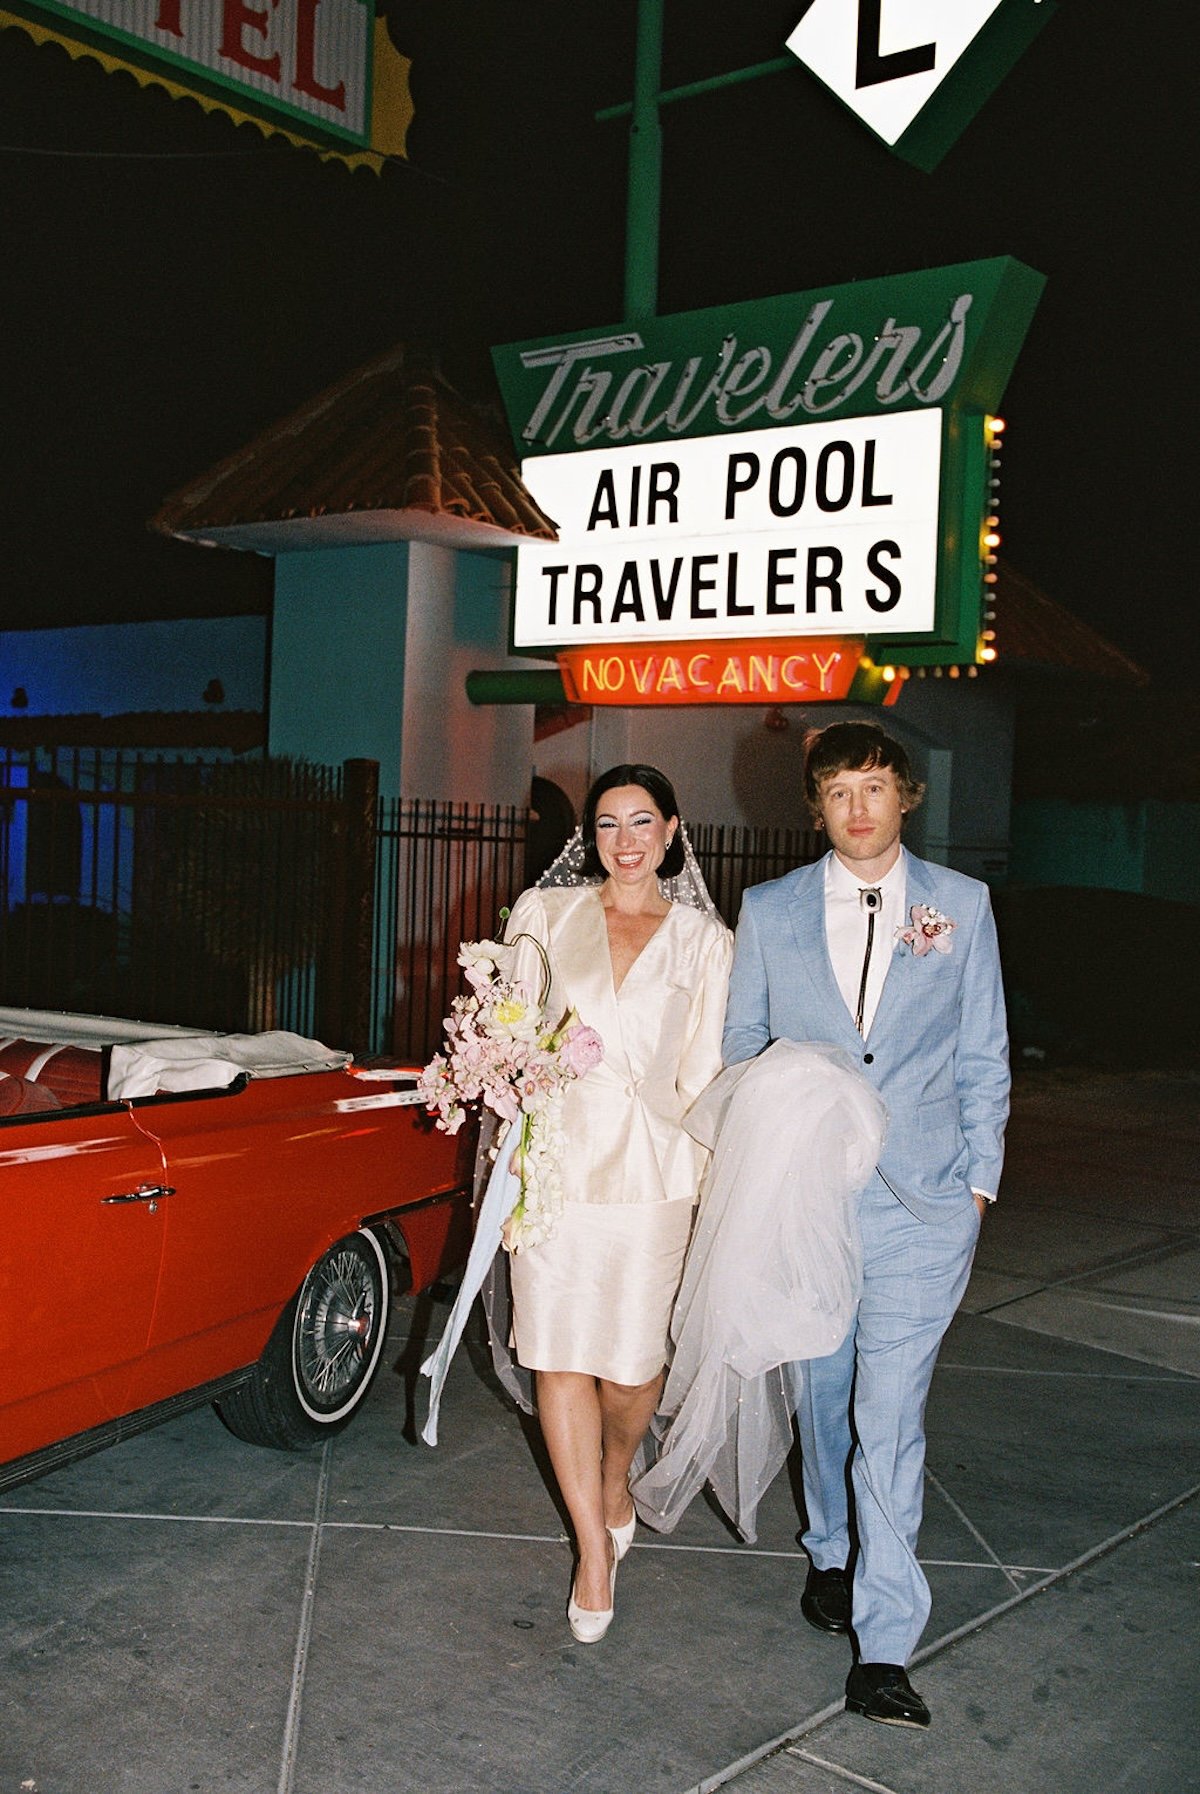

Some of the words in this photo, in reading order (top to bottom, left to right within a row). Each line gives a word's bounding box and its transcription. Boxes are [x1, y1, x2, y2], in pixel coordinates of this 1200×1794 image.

[519, 293, 974, 448] Travelers
[586, 462, 681, 532] AIR
[725, 439, 894, 520] POOL
[541, 539, 902, 626] TRAVELERS
